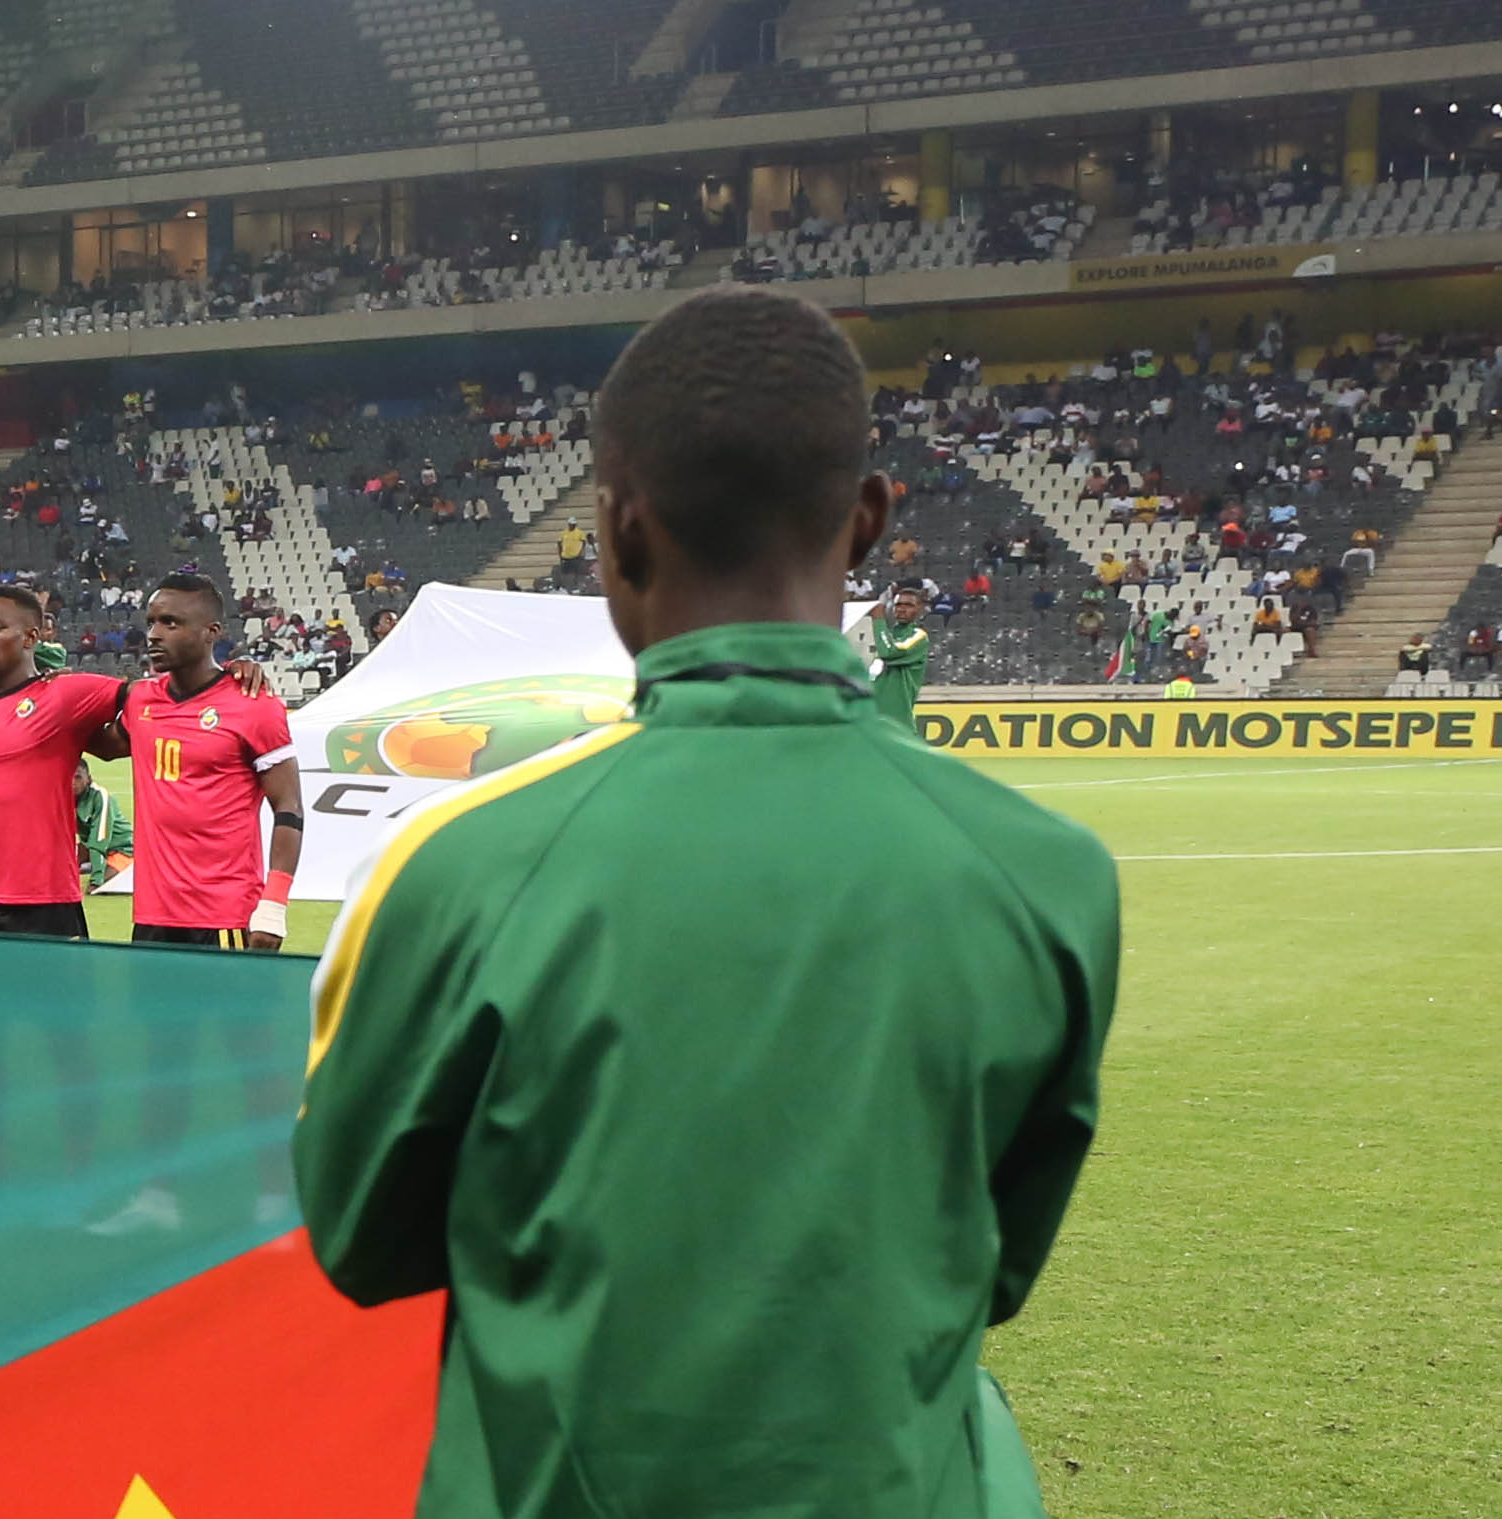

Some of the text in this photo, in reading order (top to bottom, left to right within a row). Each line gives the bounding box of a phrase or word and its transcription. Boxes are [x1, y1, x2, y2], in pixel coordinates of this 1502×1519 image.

[1077, 256, 1278, 283] EXPLORE MPUMALANGA
[1175, 711, 1476, 748] MOTSEPE
[154, 737, 182, 782] 10
